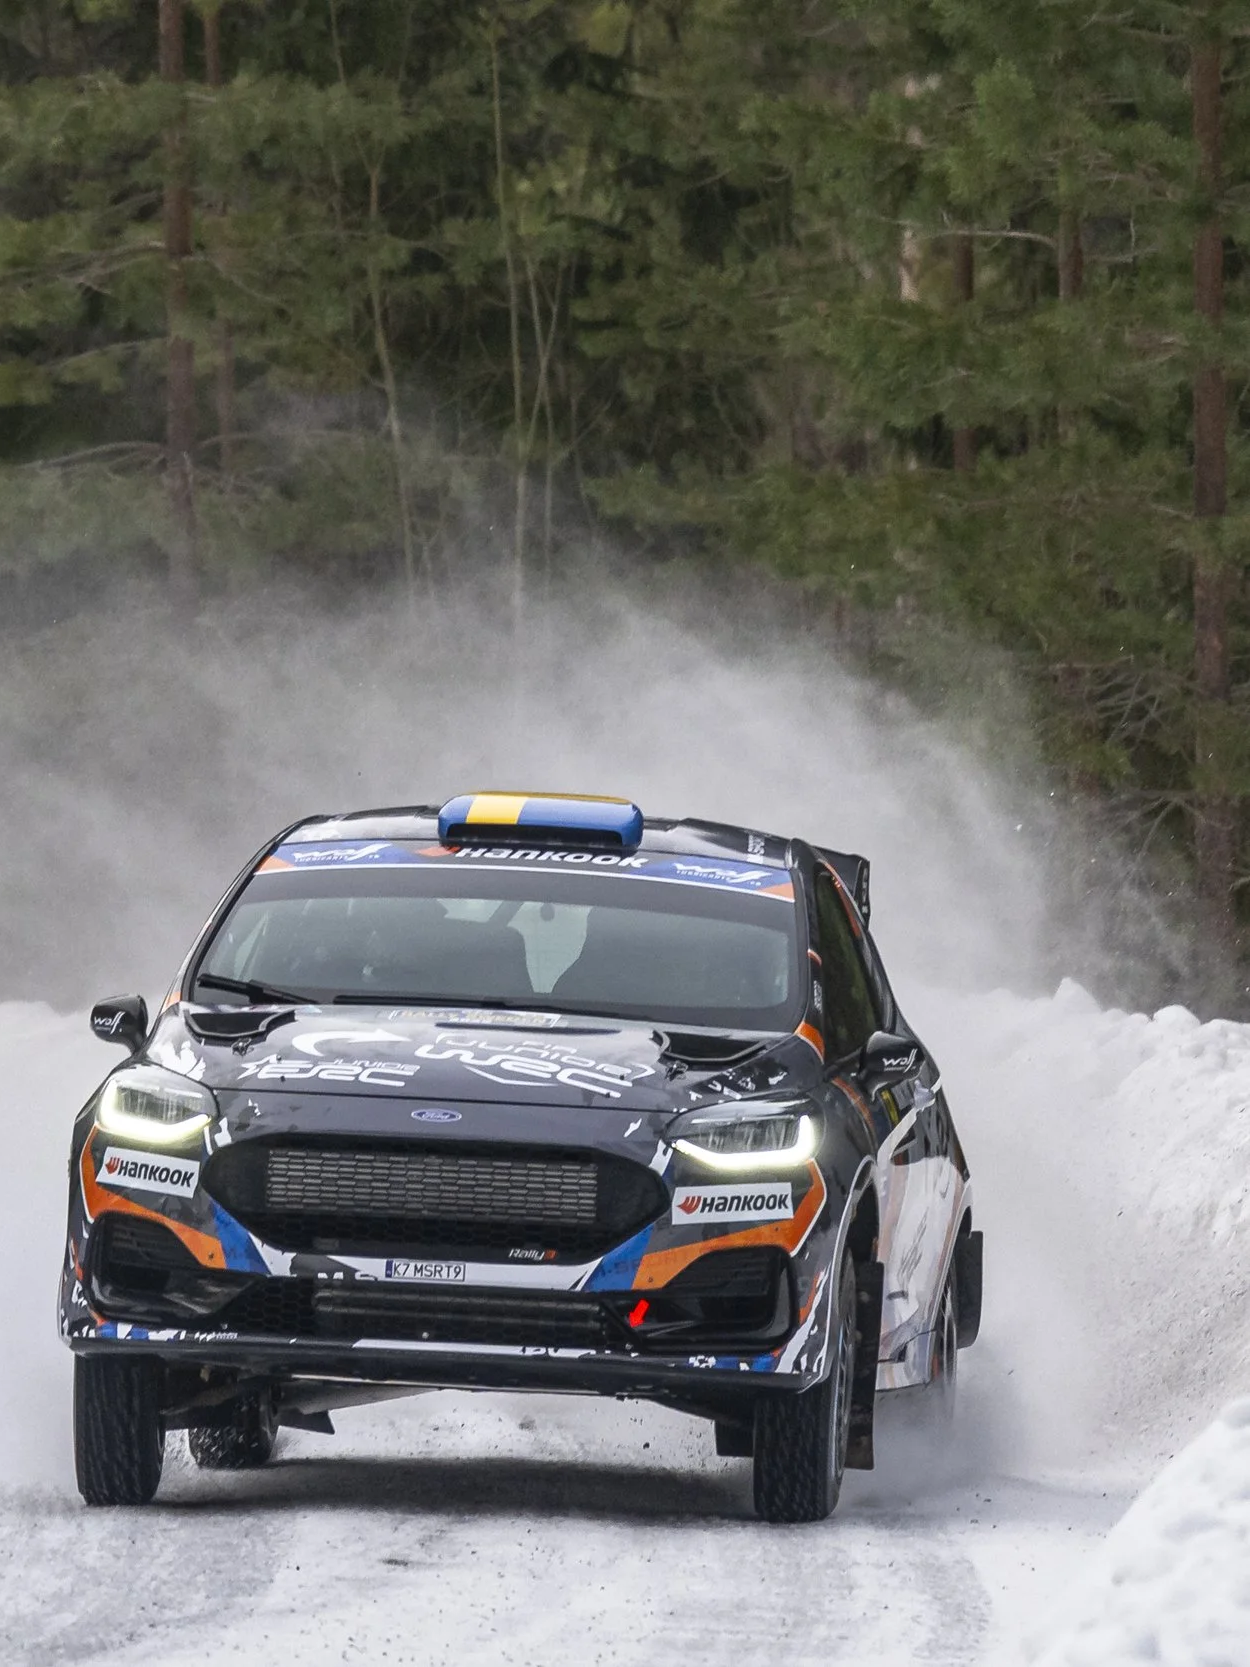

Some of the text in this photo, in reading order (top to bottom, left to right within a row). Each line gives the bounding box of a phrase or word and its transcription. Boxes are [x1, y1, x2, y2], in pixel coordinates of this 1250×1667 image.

[414, 1044, 633, 1099] WRC
[393, 1264, 410, 1277] K7
[413, 1264, 463, 1280] MSRT9
